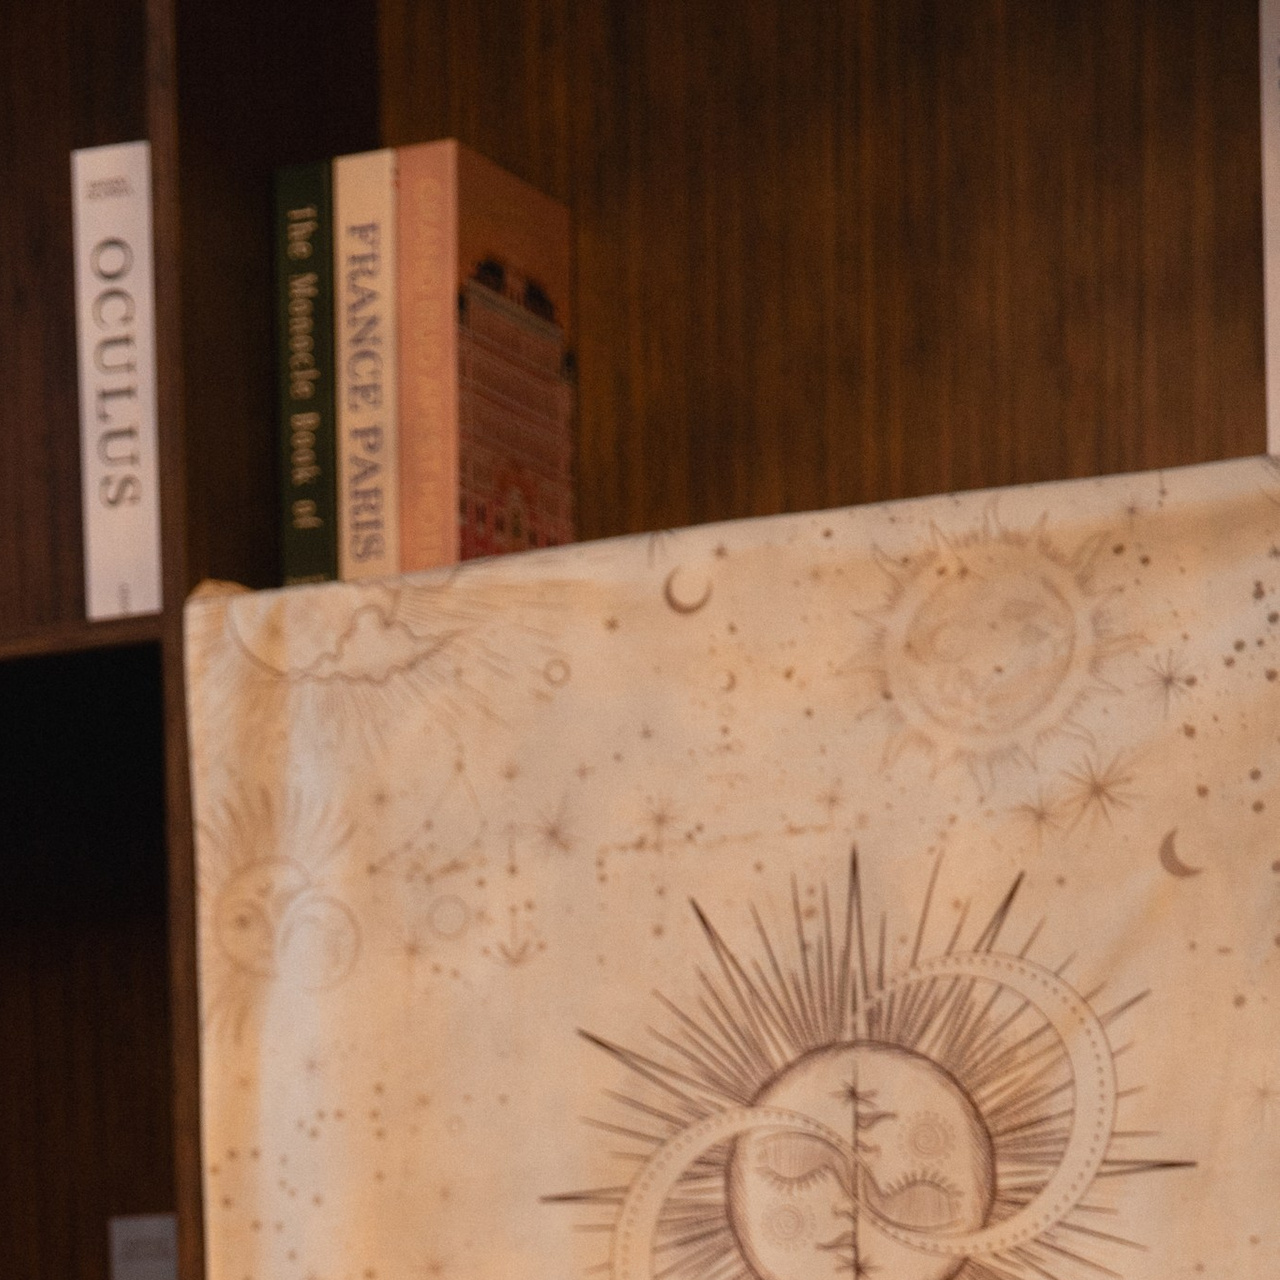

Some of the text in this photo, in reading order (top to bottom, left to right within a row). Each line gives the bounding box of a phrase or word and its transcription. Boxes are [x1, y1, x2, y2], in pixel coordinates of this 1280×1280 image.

[89, 236, 141, 508] OCULUS
[287, 207, 322, 529] The Monocle Book of
[346, 222, 385, 563] FRANCE PARIS
